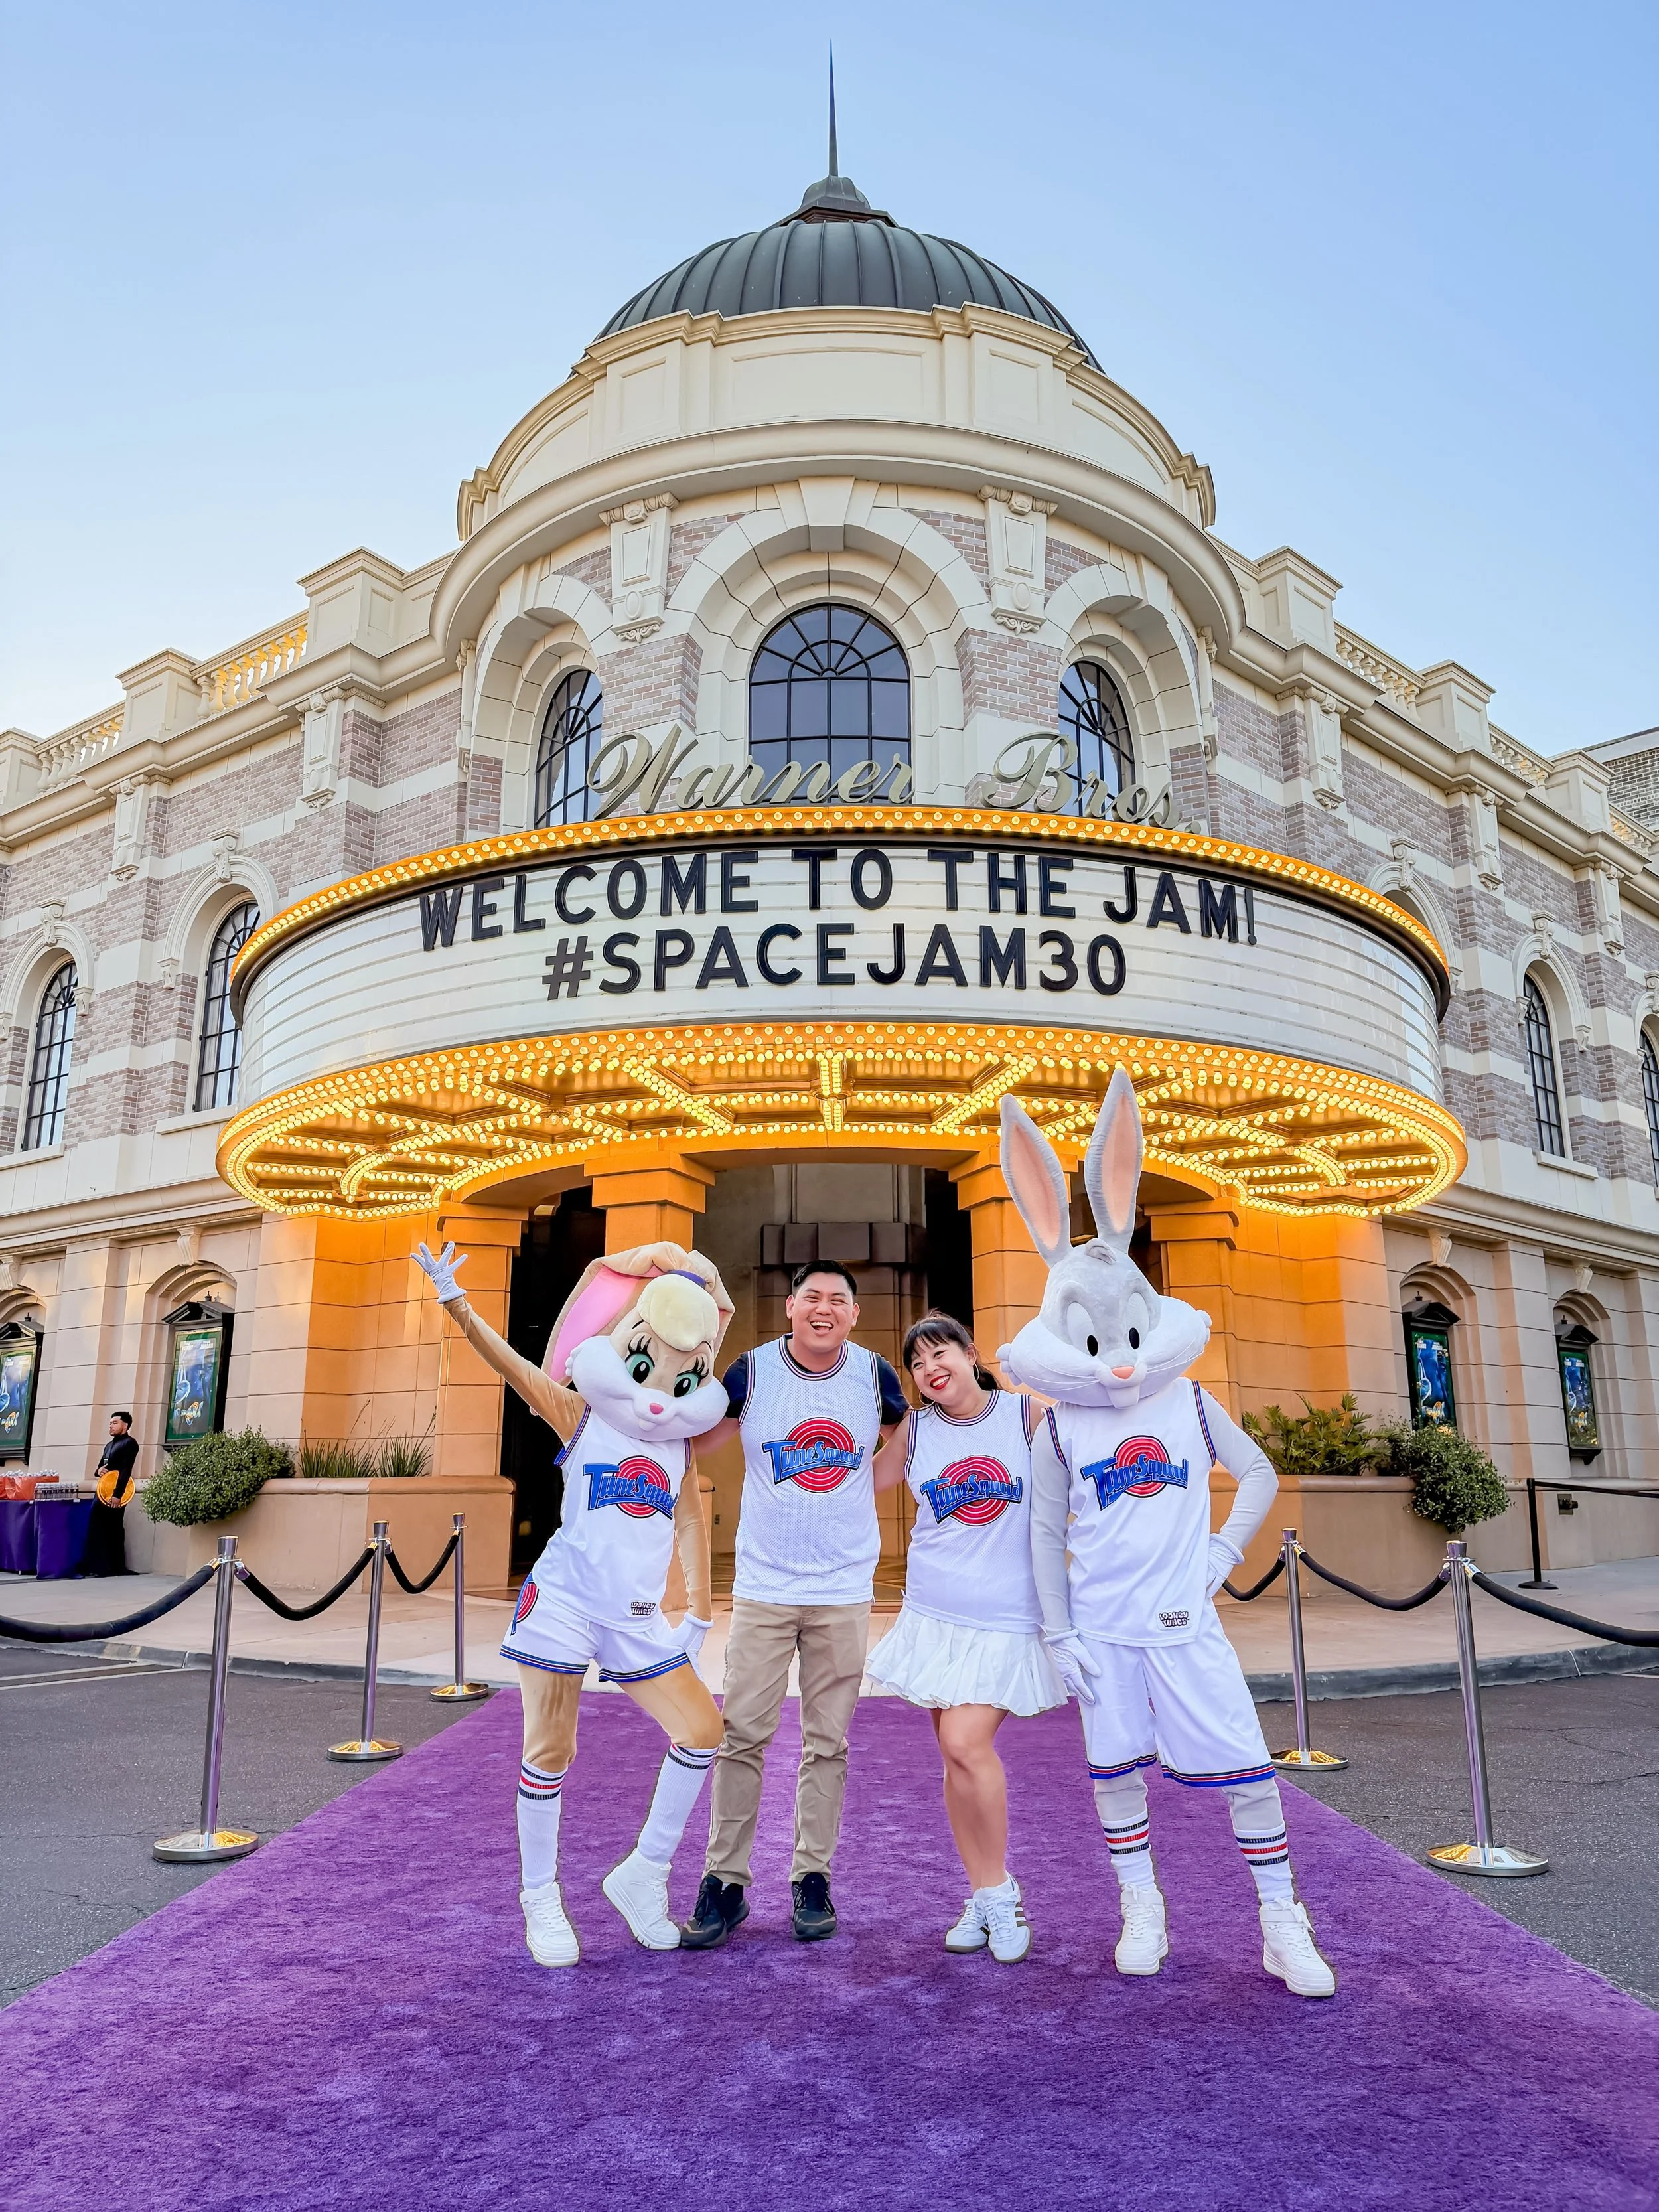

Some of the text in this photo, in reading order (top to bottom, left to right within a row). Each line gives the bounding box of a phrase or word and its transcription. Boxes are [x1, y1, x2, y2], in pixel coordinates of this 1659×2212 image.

[587, 723, 1202, 834] Warner Bros.
[419, 848, 1258, 951] WELCOME TO THE JAM!
[541, 922, 1127, 1001] #SPACEJAM30
